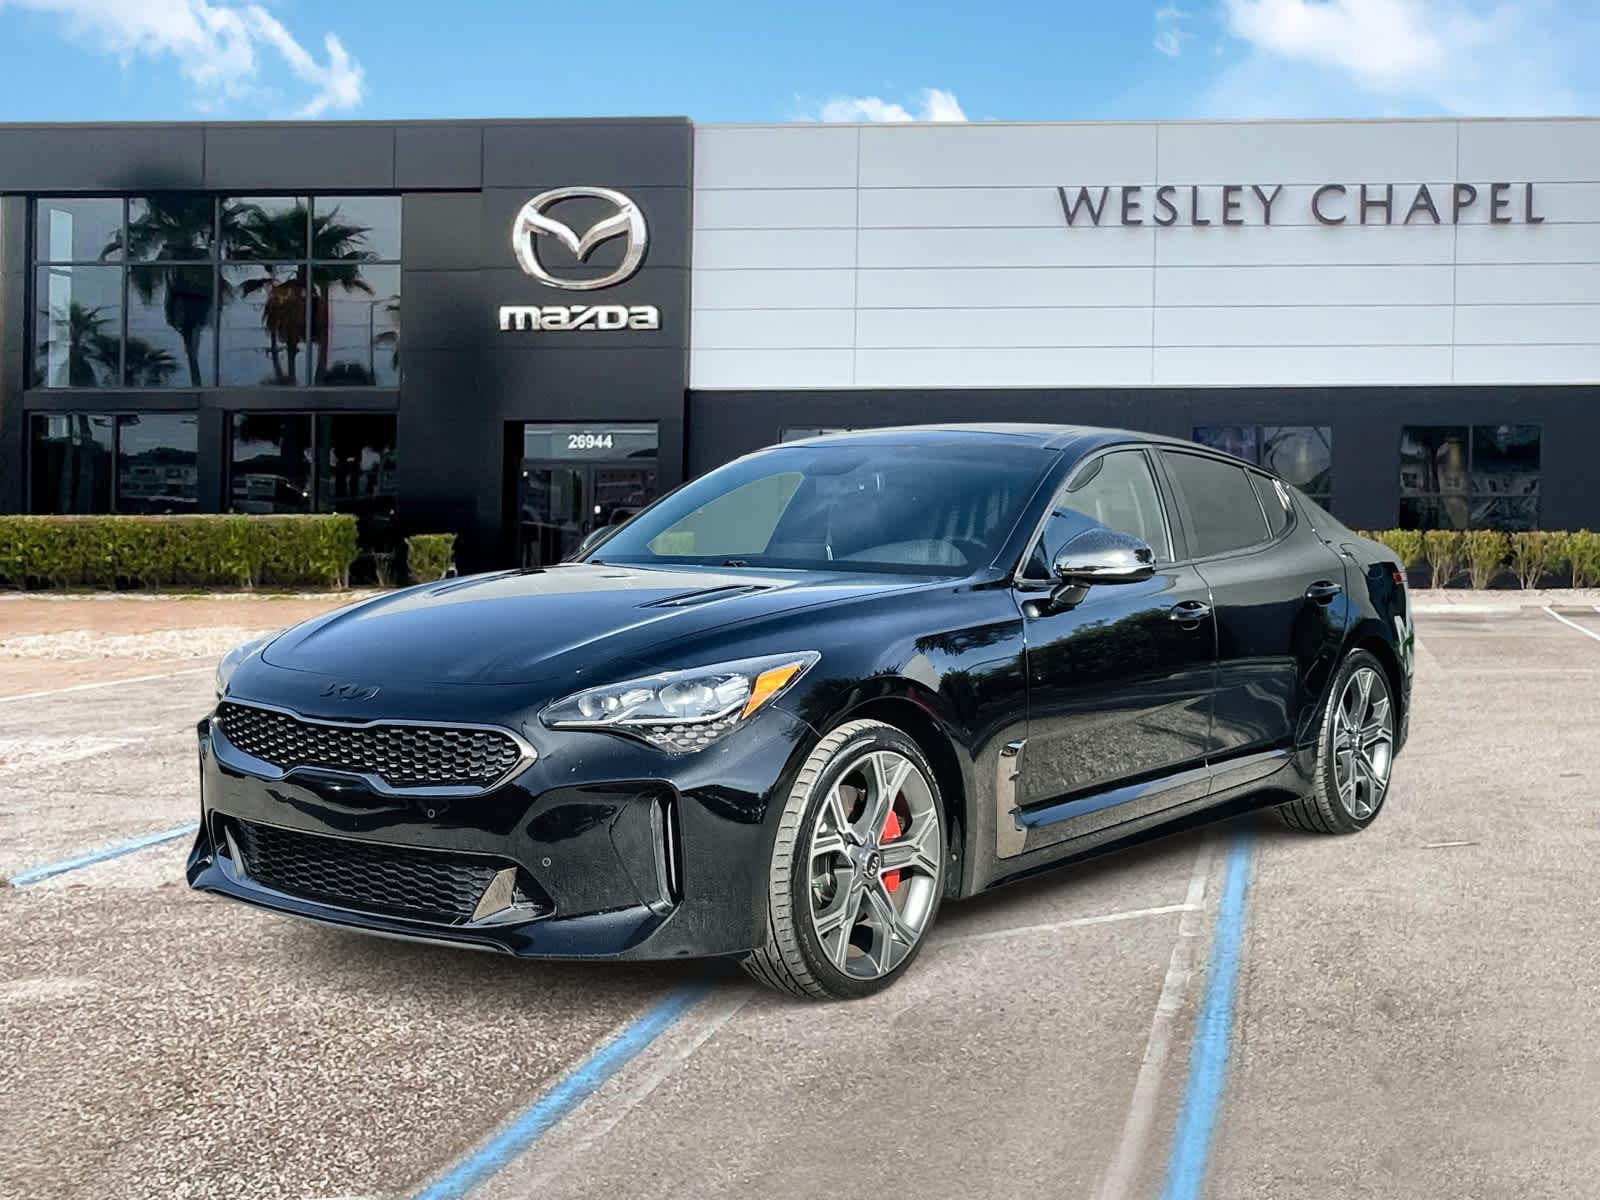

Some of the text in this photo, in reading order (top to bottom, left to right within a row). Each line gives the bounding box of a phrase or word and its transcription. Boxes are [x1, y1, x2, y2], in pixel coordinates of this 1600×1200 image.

[1057, 183, 1546, 226] WESLEY CHAPEL
[567, 434, 613, 449] 26944
[868, 855, 880, 876] KIA
